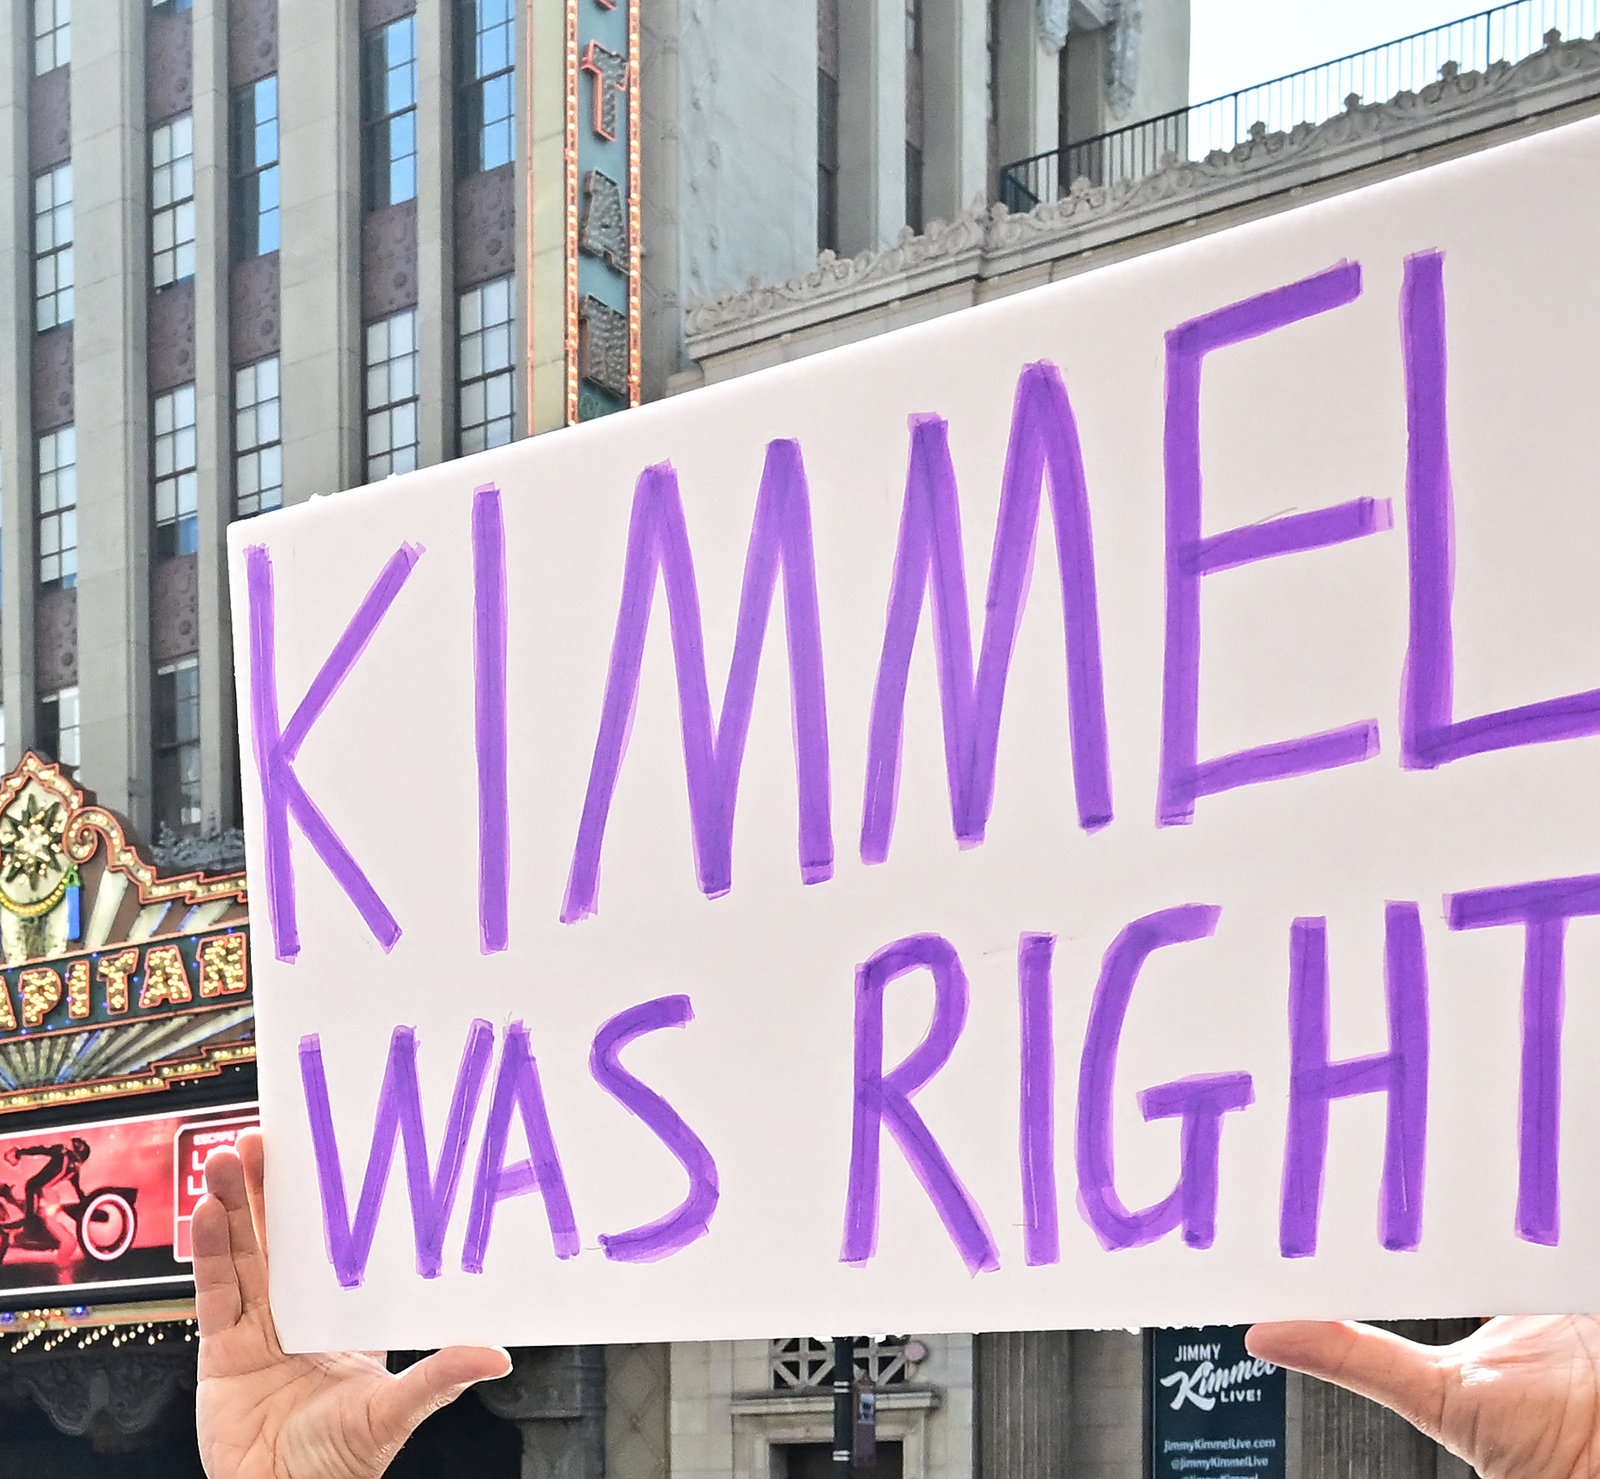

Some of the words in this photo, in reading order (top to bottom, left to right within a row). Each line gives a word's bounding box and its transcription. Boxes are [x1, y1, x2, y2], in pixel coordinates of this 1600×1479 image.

[297, 993, 720, 1288] WAS
[1174, 1343, 1221, 1363] JIMMY
[1220, 1389, 1262, 1403] LIVE!
